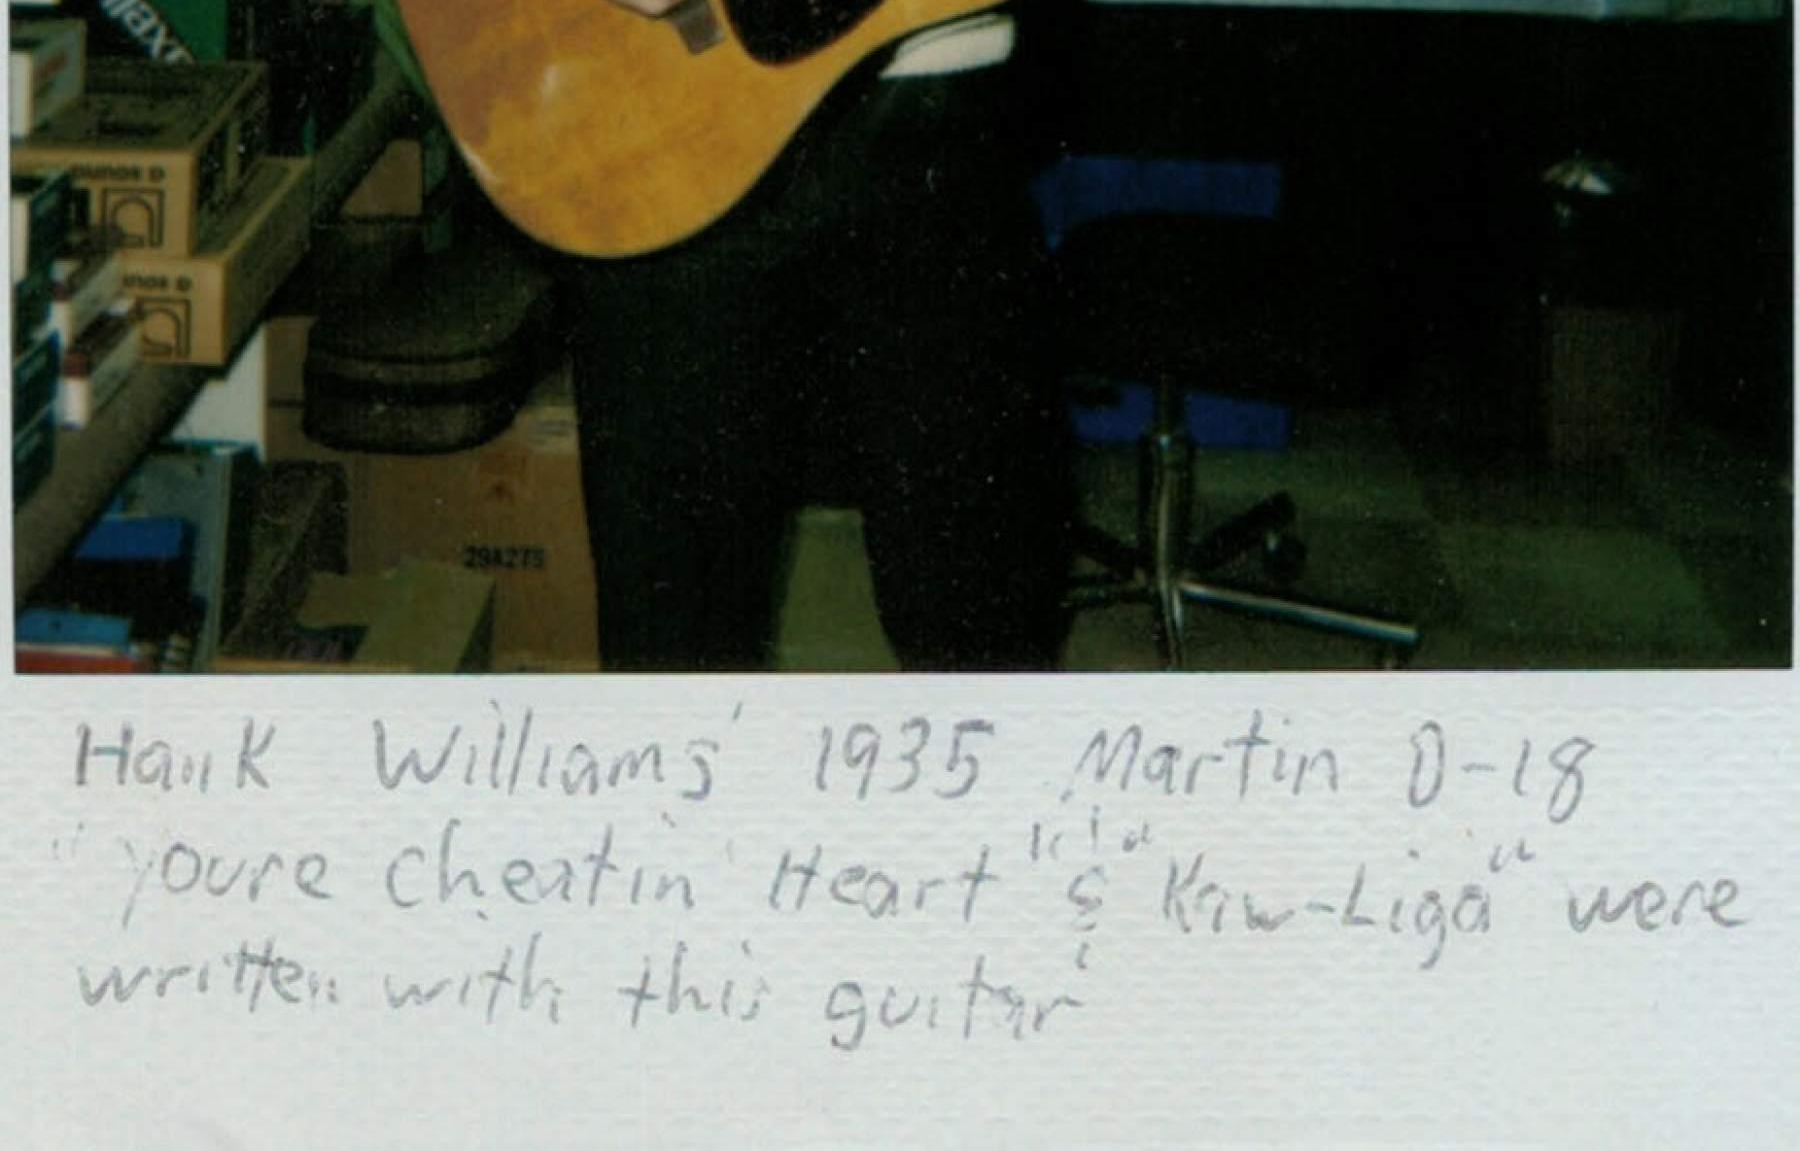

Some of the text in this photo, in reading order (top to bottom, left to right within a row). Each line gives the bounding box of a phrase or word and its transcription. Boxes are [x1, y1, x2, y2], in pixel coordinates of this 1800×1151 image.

[75, 717, 276, 794] Hank
[815, 717, 995, 799] 1935
[1061, 709, 1339, 803] Martin
[1408, 720, 1597, 826] D-18
[1567, 879, 1754, 933] were
[76, 932, 1084, 1051] written with this guitar
